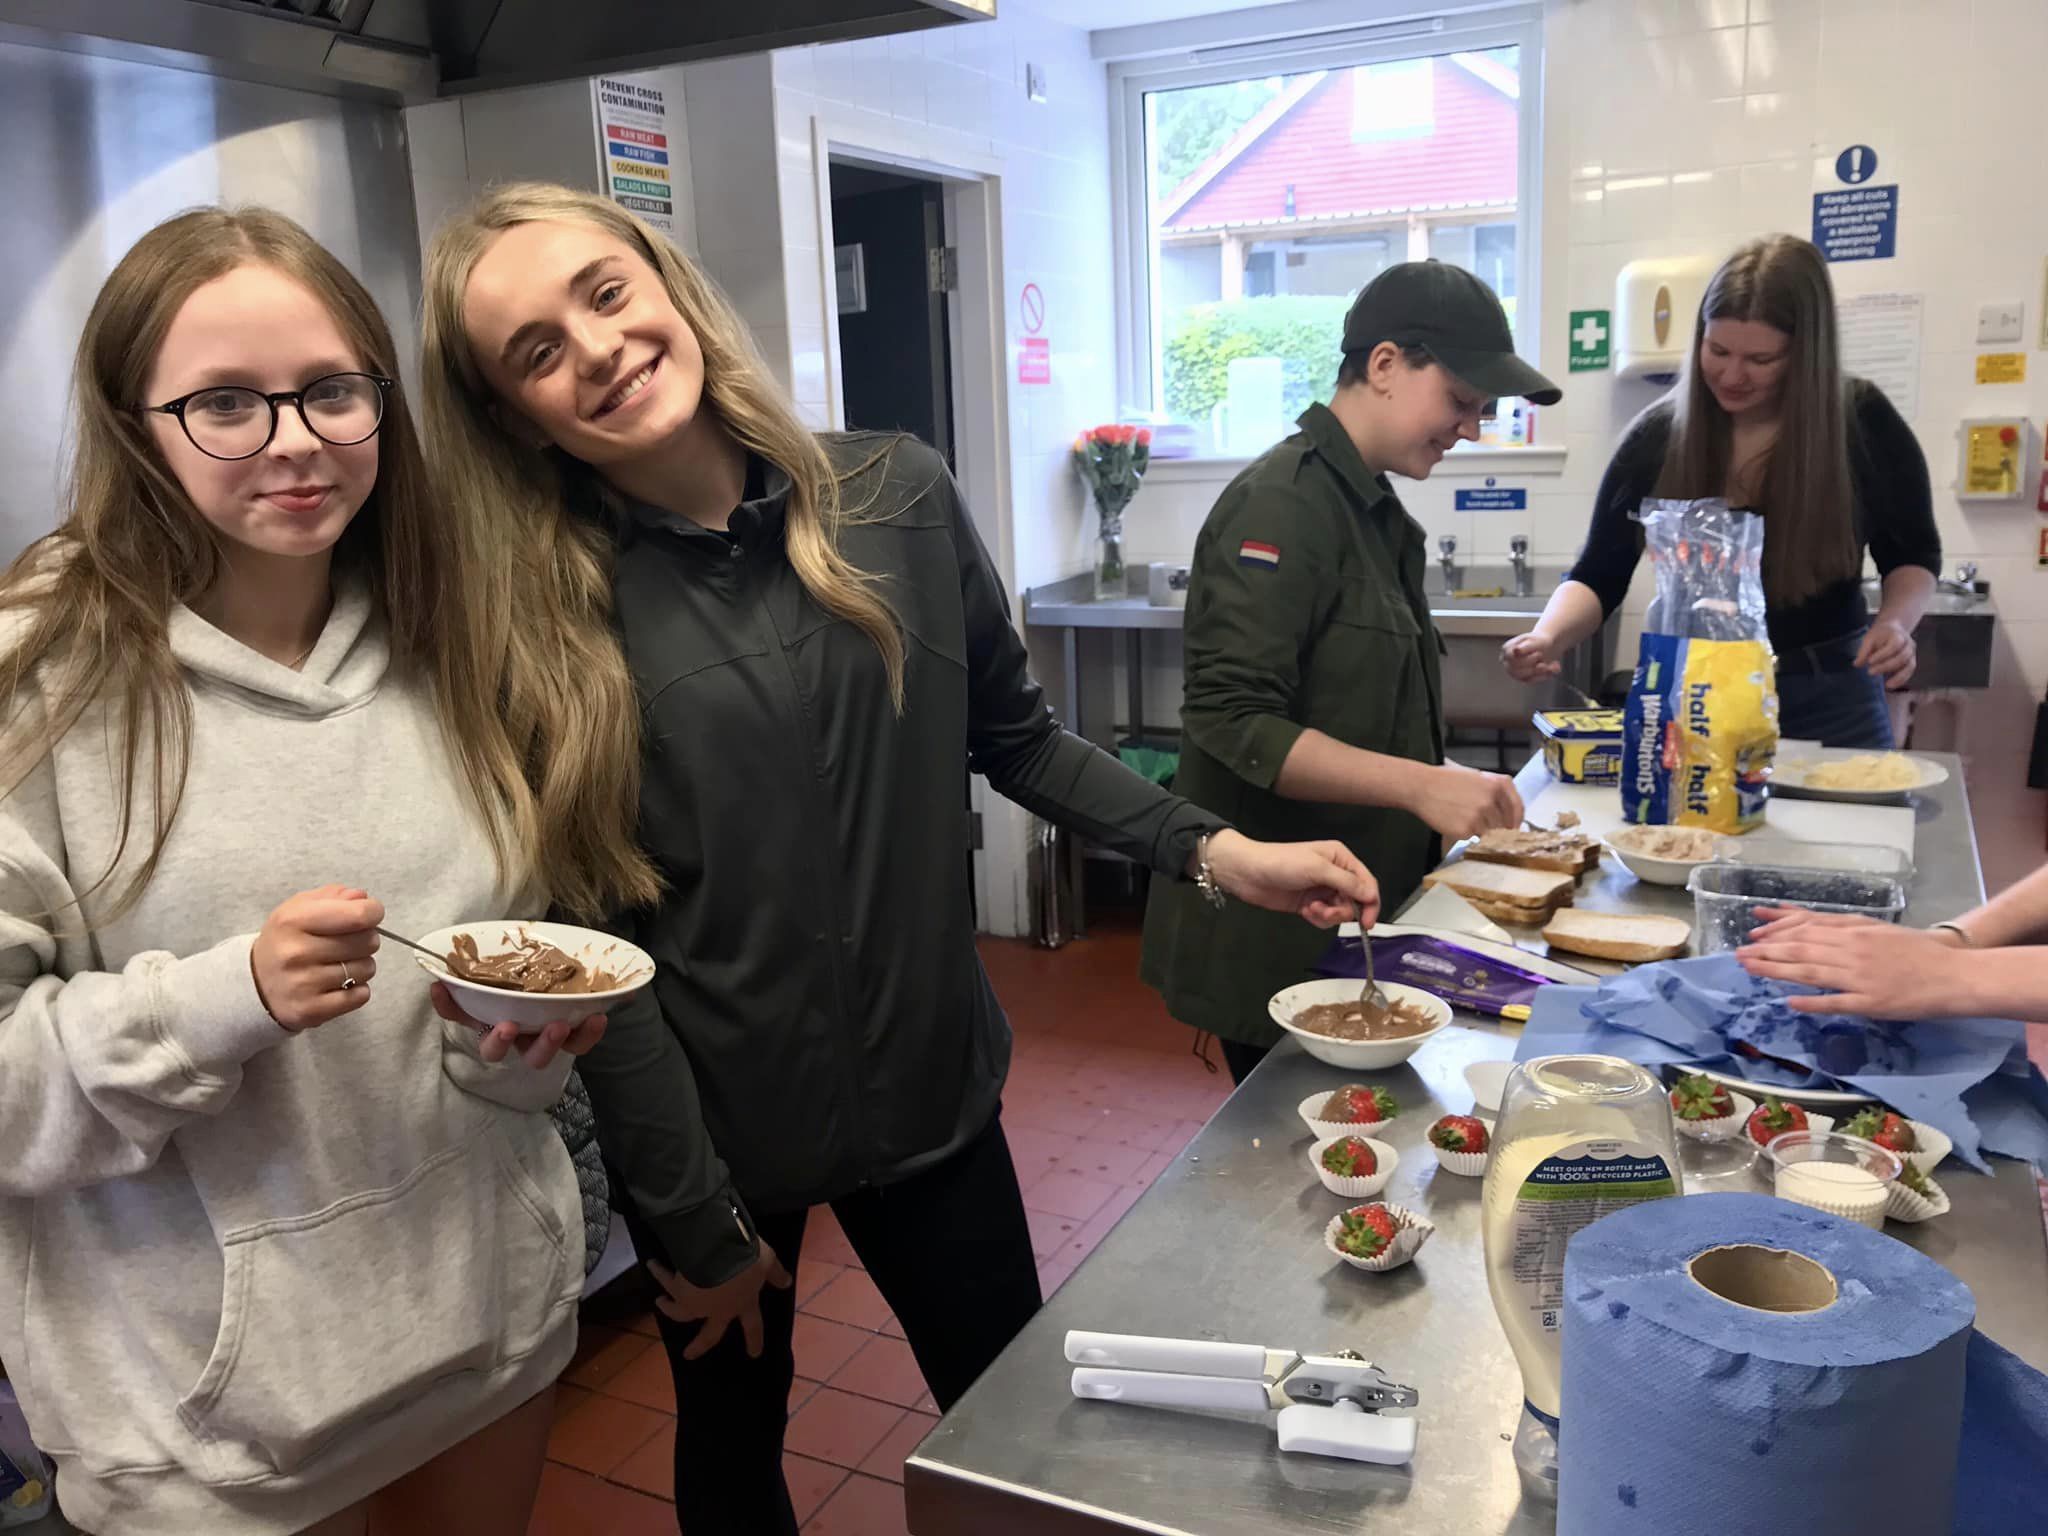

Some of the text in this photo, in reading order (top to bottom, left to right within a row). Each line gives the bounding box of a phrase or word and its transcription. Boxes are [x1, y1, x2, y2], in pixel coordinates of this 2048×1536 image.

[600, 79, 663, 102] PREVENT CROSS
[601, 92, 665, 116] CONTAMINATION
[620, 128, 654, 145] RAW MEAT
[624, 146, 656, 161] RAW FISH
[616, 161, 665, 180] COOKED MEATS
[615, 179, 640, 192] SALADS
[648, 184, 669, 197] FRUITS
[624, 197, 665, 213] VEGETABLES
[1637, 693, 1662, 794] Warburtons
[1688, 683, 1712, 816] half half
[1604, 1164, 1633, 1172] BOTTLE
[1633, 1170, 1664, 1178] PLASTIC
